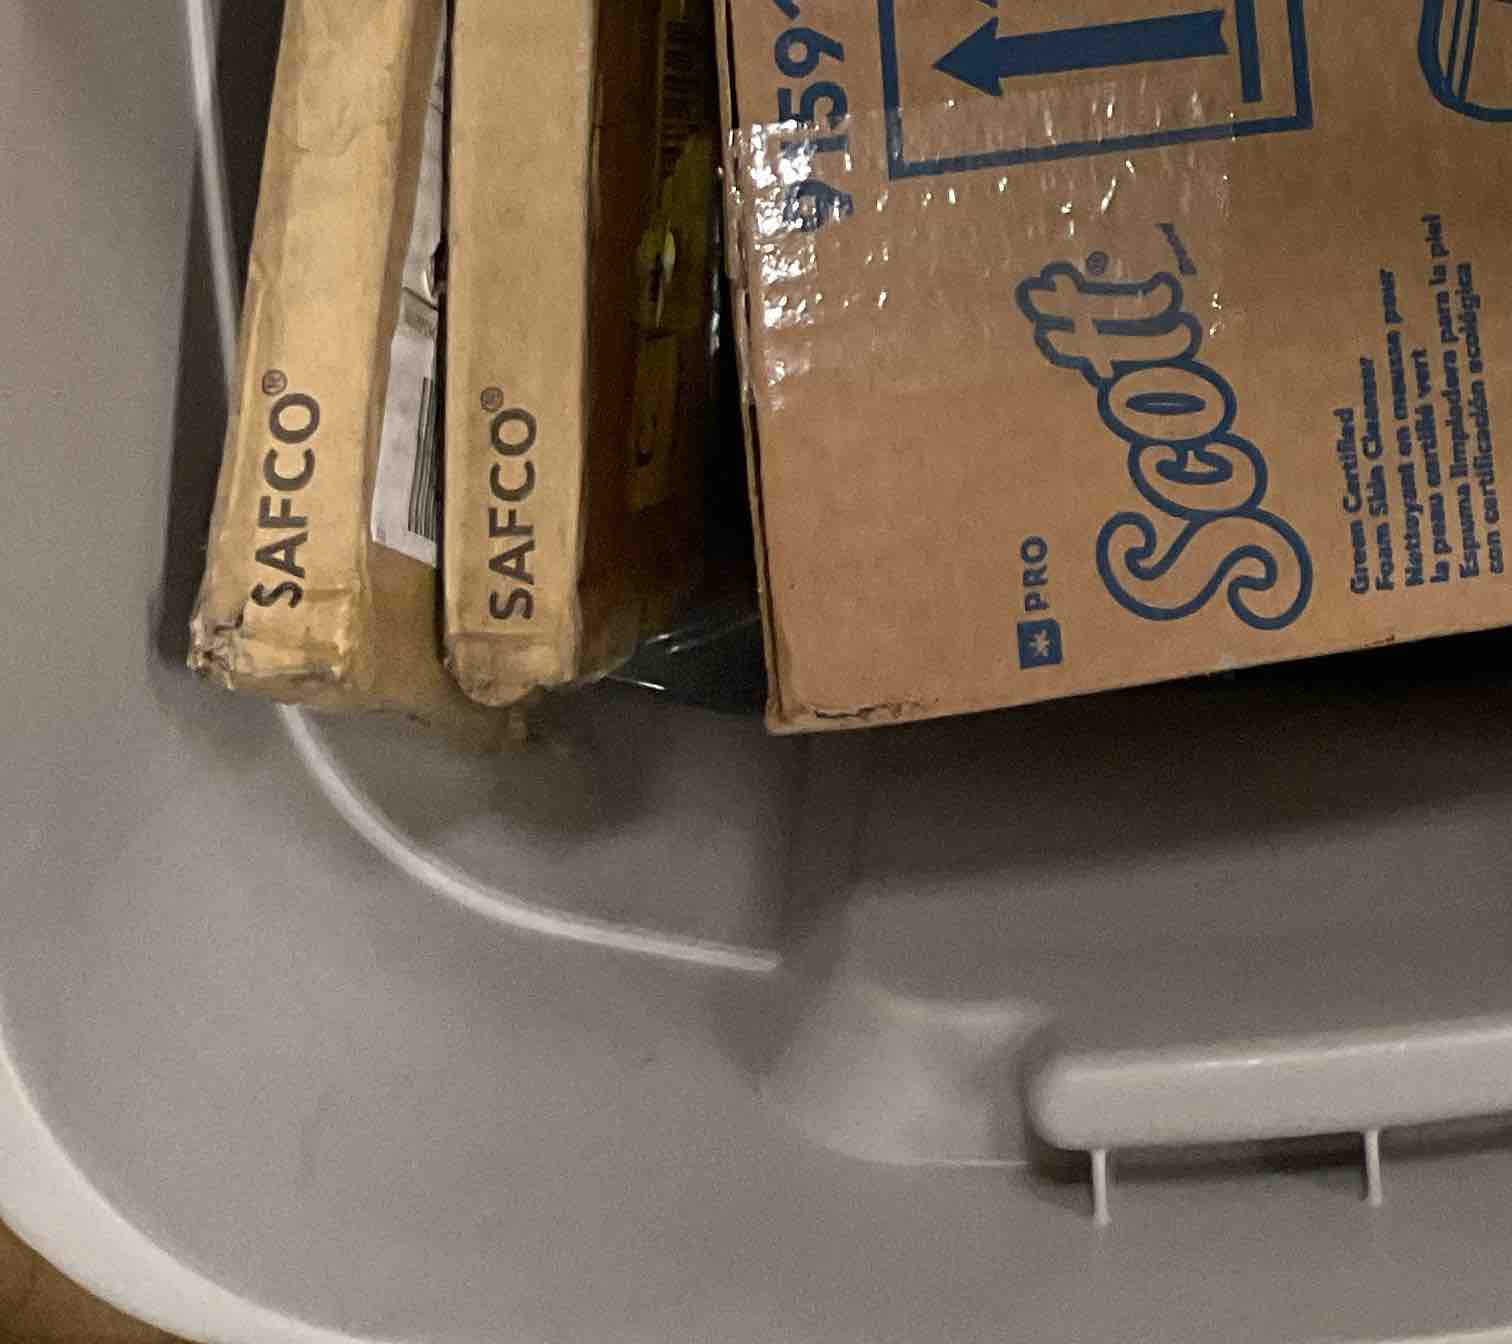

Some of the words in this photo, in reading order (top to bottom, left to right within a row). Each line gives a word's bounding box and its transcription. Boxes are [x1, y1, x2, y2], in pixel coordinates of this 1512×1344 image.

[1428, 265, 1447, 285] la
[1435, 291, 1458, 342] para
[1410, 349, 1431, 398] vert
[1334, 408, 1362, 513] Certified
[1349, 520, 1370, 594] Green
[1374, 523, 1395, 590] Foam
[1457, 483, 1481, 578] Espuma
[1487, 531, 1504, 575] con
[1020, 536, 1050, 612] PRO
